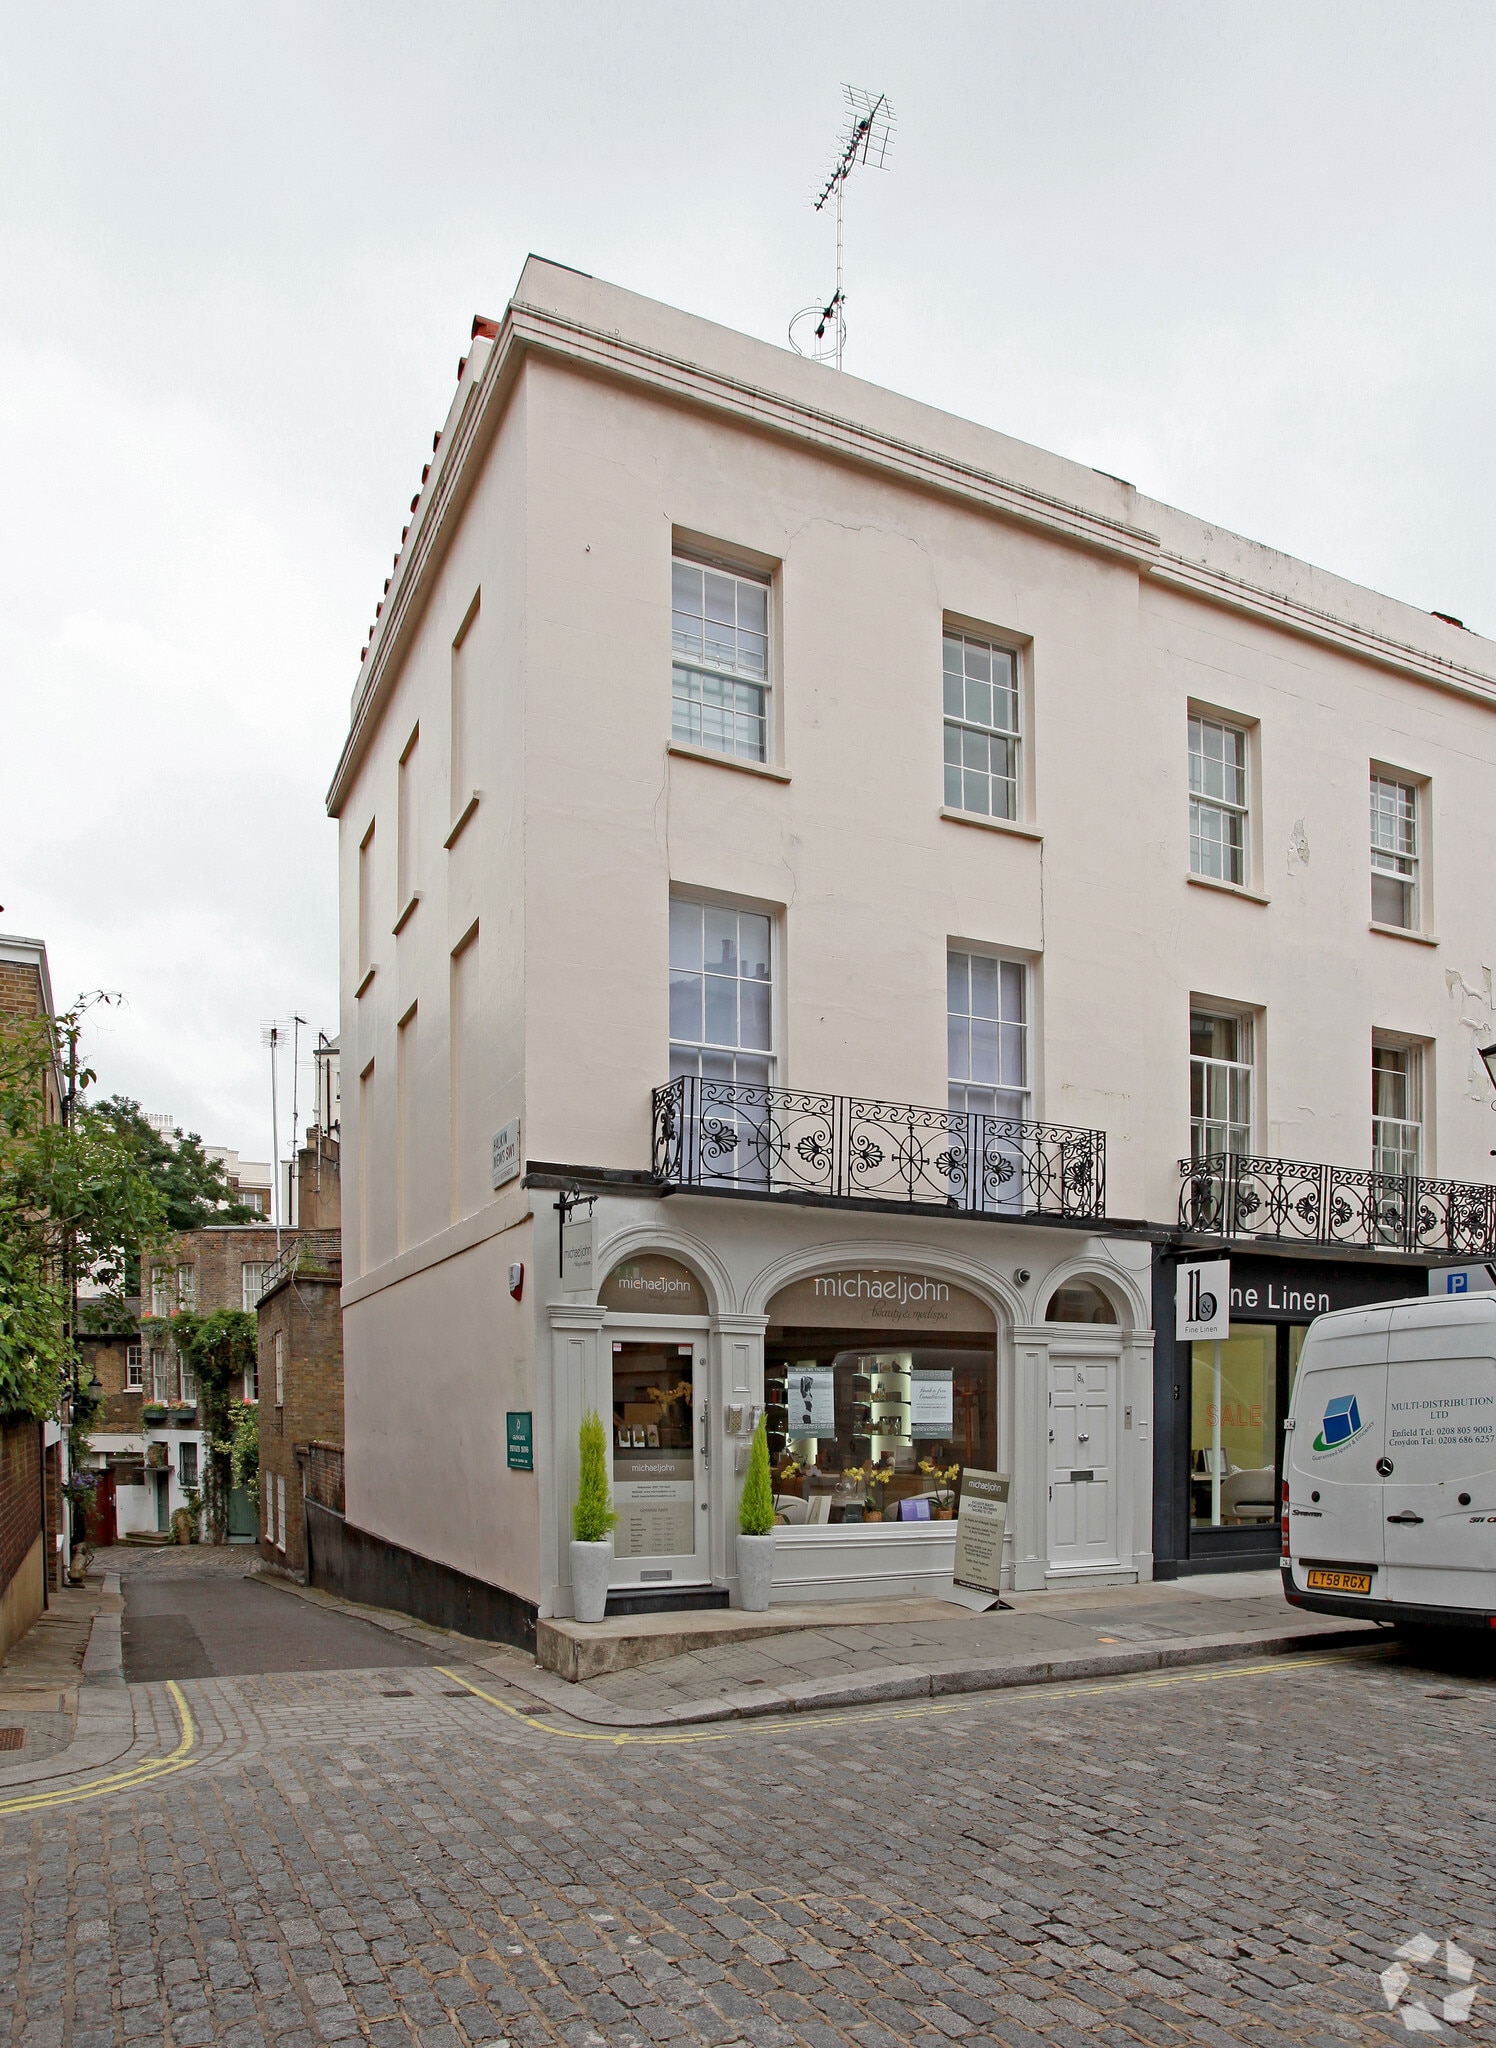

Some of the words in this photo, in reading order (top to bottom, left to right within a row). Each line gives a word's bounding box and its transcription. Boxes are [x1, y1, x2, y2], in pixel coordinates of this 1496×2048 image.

[564, 1245, 591, 1260] michaeljohn
[618, 1277, 691, 1293] michaeljohn
[816, 1273, 949, 1304] michaeljohn
[1452, 1276, 1464, 1293] P
[1268, 1284, 1330, 1312] Linen
[867, 1300, 901, 1323] beauty
[913, 1304, 949, 1324] medispa
[1391, 1397, 1494, 1411] MULTI-DISTRIBUTION
[1206, 1404, 1262, 1426] SALE
[1430, 1411, 1449, 1420] LTD
[1392, 1429, 1418, 1437] Enfield
[1420, 1428, 1434, 1436] Tel:
[1437, 1427, 1455, 1435] 0208
[1457, 1426, 1471, 1434] 805
[1473, 1425, 1493, 1433] 9003
[1338, 1442, 1352, 1454] Speed
[1389, 1438, 1419, 1447] Croydon
[1421, 1437, 1436, 1445] Tel:
[1438, 1436, 1457, 1444] 0208
[1459, 1435, 1473, 1443] 686
[1476, 1435, 1495, 1443] 6257
[631, 1464, 675, 1473] michaeljohn
[968, 1480, 1002, 1492] michaeljohn
[1312, 1572, 1340, 1586] LT58
[1342, 1575, 1366, 1589] RGX
